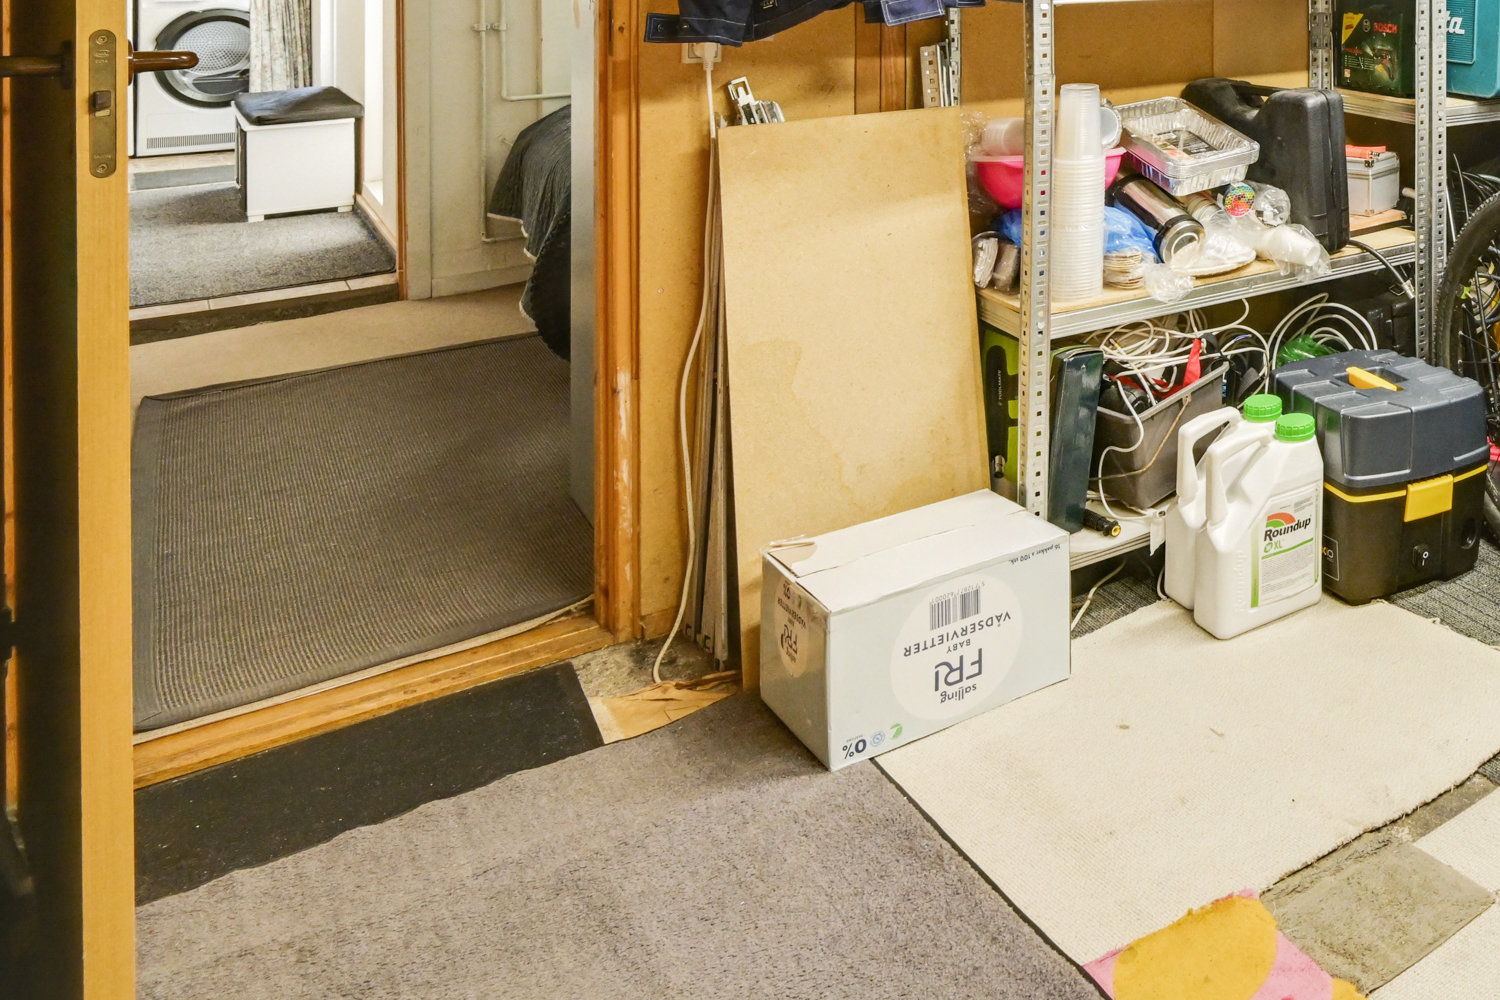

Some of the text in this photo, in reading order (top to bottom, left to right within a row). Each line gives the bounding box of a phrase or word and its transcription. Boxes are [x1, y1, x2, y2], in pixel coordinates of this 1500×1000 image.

[1373, 22, 1398, 34] BOSCH
[1263, 517, 1311, 542] Roundup
[1274, 540, 1283, 550] XL
[903, 611, 1011, 657] VÅDSERVIETTER
[946, 638, 971, 654] BABY
[935, 648, 982, 692] FRI
[940, 683, 977, 704] salling
[842, 739, 867, 759] 0%
